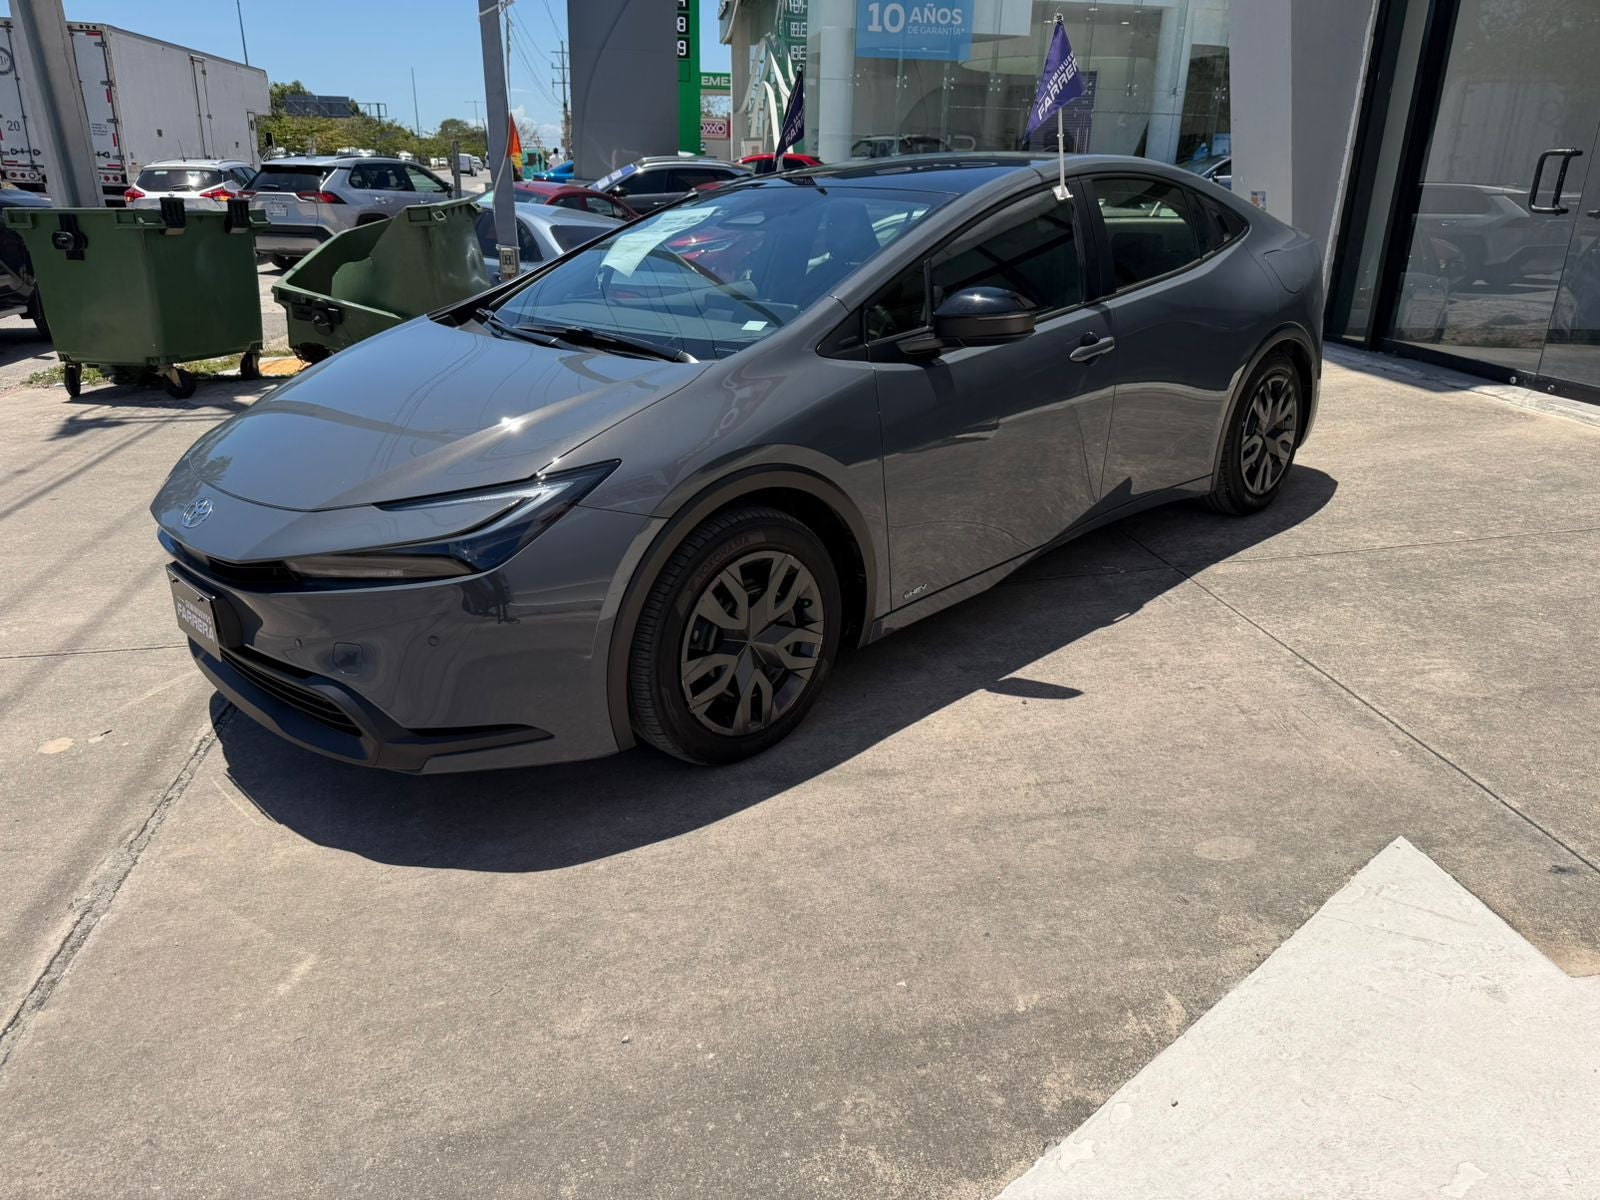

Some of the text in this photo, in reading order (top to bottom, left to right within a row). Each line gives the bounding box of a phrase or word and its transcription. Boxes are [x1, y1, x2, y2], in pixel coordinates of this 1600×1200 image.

[867, 2, 963, 33] 10 AÑOS
[907, 25, 919, 34] DE
[701, 76, 731, 86] EME
[6, 120, 20, 131] 20
[177, 602, 215, 643] FARRERA
